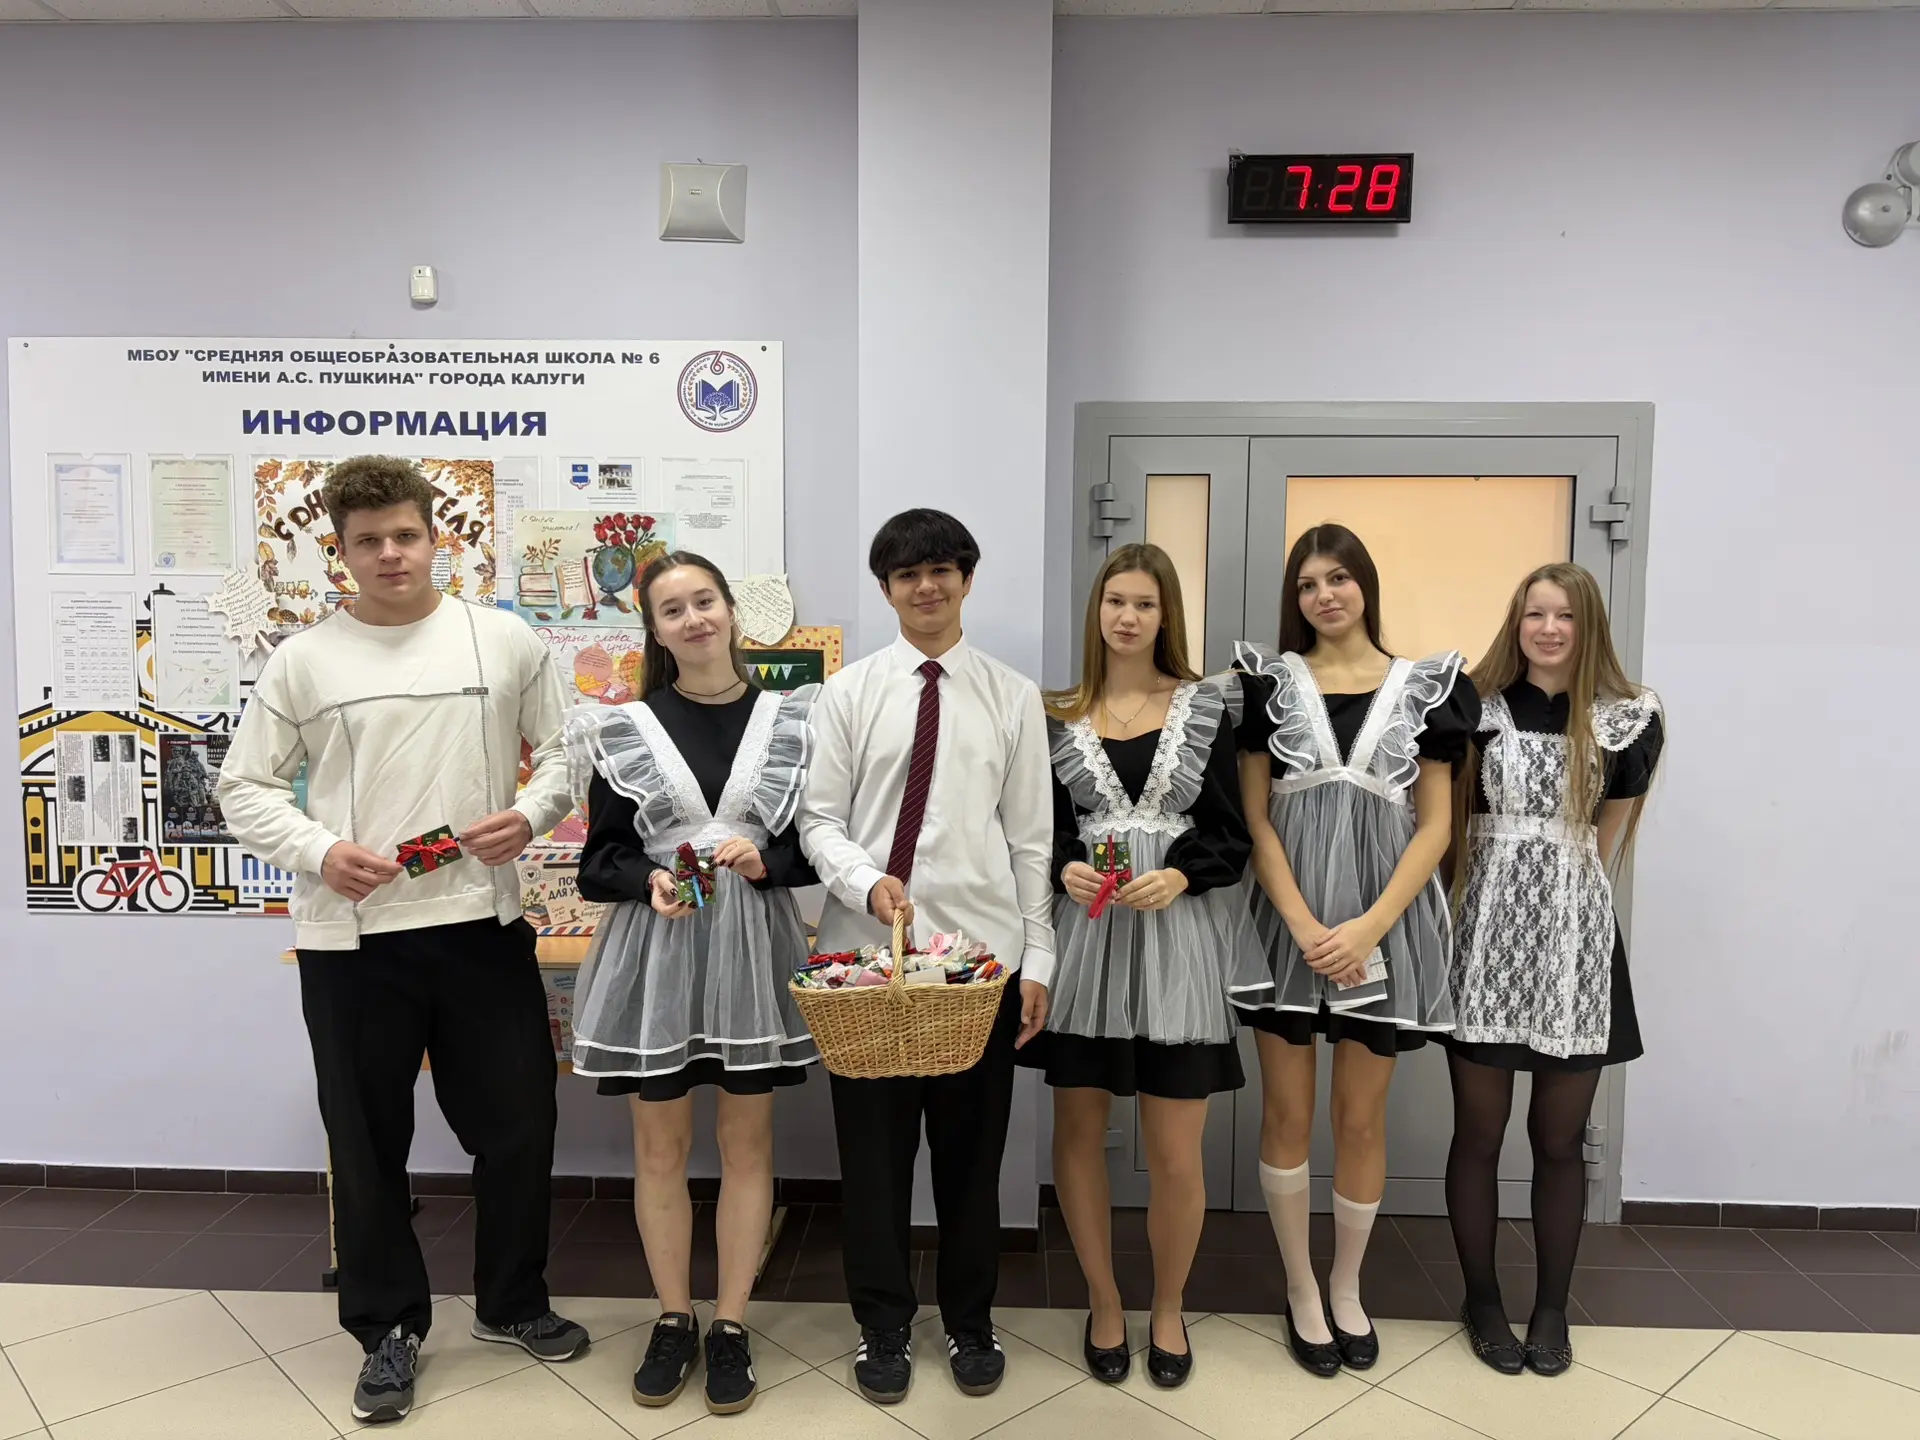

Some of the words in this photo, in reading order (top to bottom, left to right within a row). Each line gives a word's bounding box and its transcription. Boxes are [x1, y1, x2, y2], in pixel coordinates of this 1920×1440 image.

[1287, 165, 1400, 211] 7:28
[128, 350, 179, 362] МБОУ
[185, 350, 283, 364] "СРЕДНЯЯ
[290, 351, 538, 365] ОБЩЕОБРАЗОВАТЕЛЬНАЯ
[545, 352, 615, 364] ШКОЛА
[621, 352, 642, 364] №
[649, 352, 660, 365] 6
[203, 371, 270, 383] ИМЕНИ
[277, 372, 313, 384] А.С.
[319, 372, 423, 385] ПУШКИНА"
[429, 373, 505, 387] ГОРОДА
[511, 373, 585, 385] КАЛУГИ
[243, 410, 546, 441] ИНФОРМАЦИЯ
[548, 888, 568, 901] ДЛЯ
